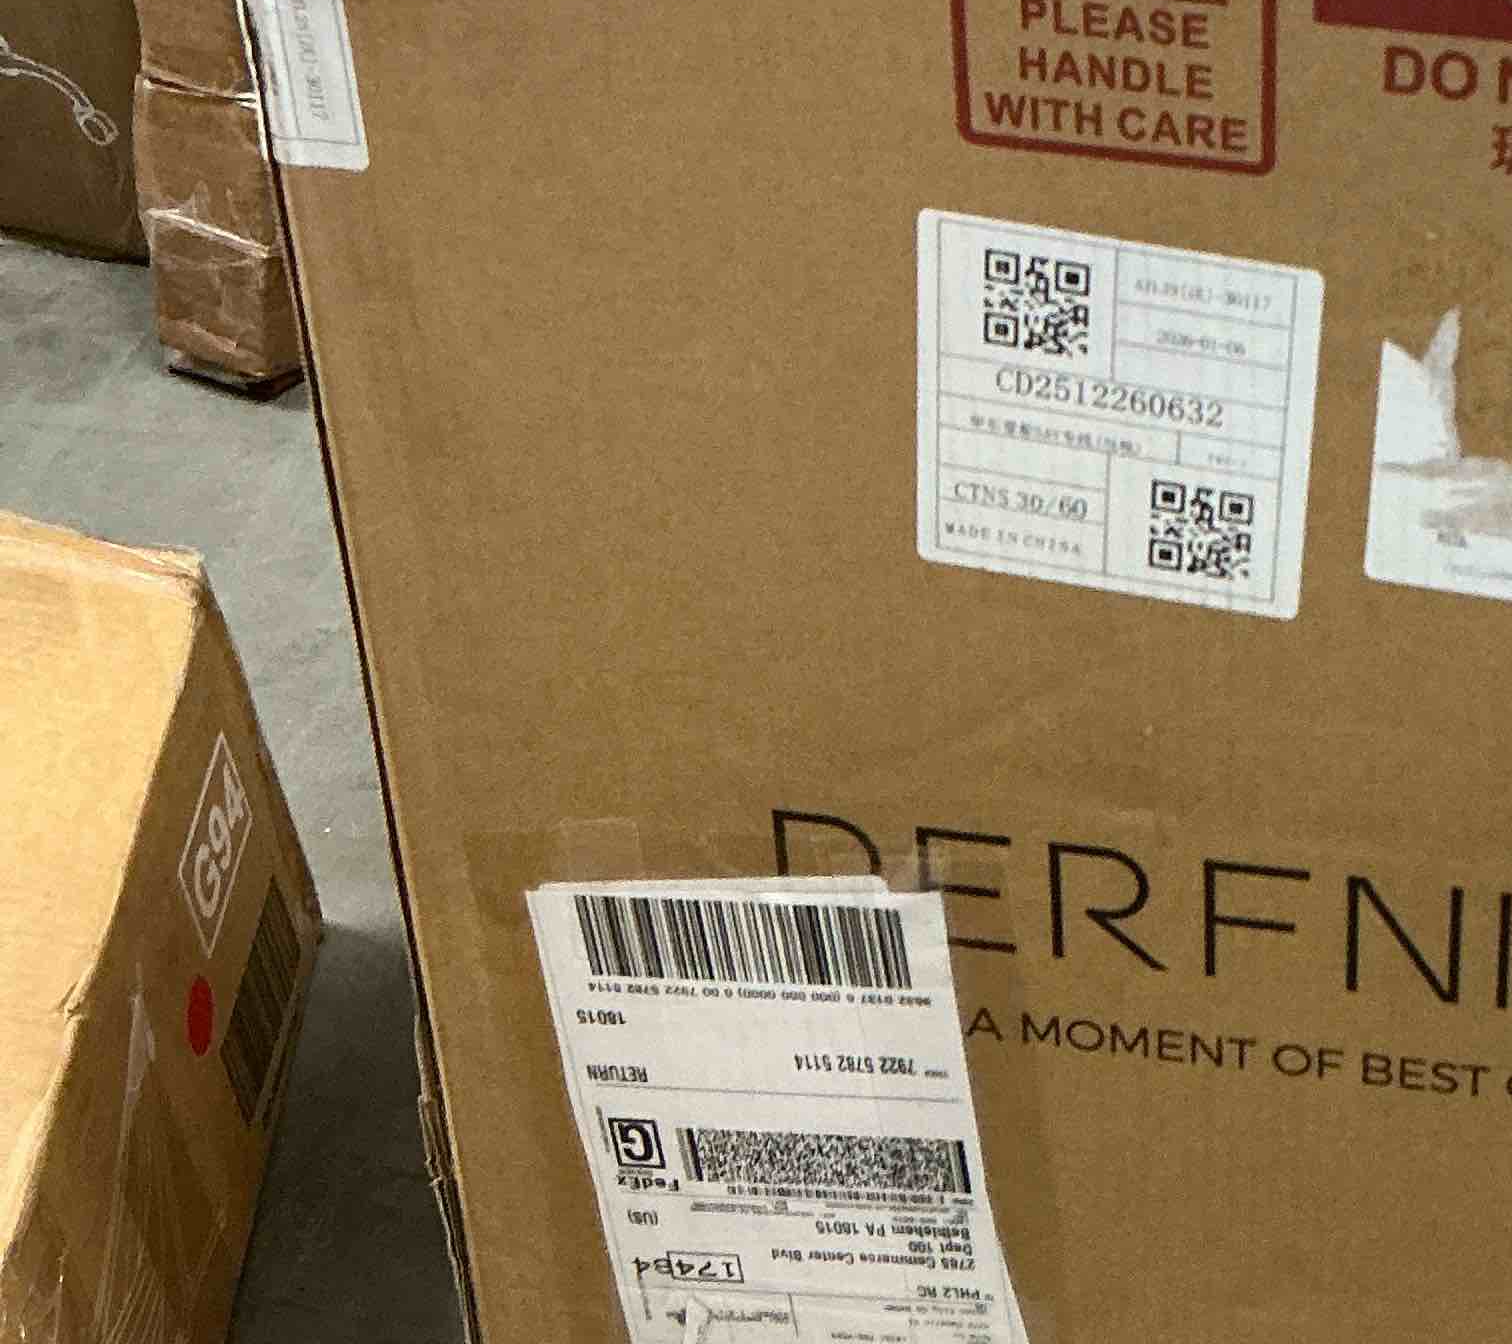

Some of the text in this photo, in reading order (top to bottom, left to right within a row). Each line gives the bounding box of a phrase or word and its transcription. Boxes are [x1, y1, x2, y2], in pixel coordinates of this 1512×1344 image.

[1018, 46, 1214, 100] HANDLE
[1383, 44, 1478, 102] DO
[984, 91, 1248, 153] WITH CARE
[994, 364, 1225, 430] CD2512260632
[1014, 489, 1088, 523] 30/60
[945, 521, 993, 543] MADE
[996, 529, 1019, 545] IN
[576, 1009, 627, 1025] 18015
[793, 1053, 916, 1075] 7922 5782 5114
[966, 1008, 1006, 1043] A
[1018, 1016, 1259, 1073] MOMENT
[1272, 1042, 1346, 1081] OF
[1361, 1052, 1489, 1104] BEST
[586, 1064, 649, 1083] RETURN
[616, 1175, 680, 1193] FedEx
[626, 1209, 659, 1227] (US)
[815, 1221, 969, 1239] Bethlehem PA 18015
[770, 1248, 802, 1263] Blvd
[939, 1240, 972, 1256] Dept
[807, 1251, 855, 1266] Center
[858, 1252, 936, 1269] Commerce
[916, 1285, 979, 1300] PHL2 RC
